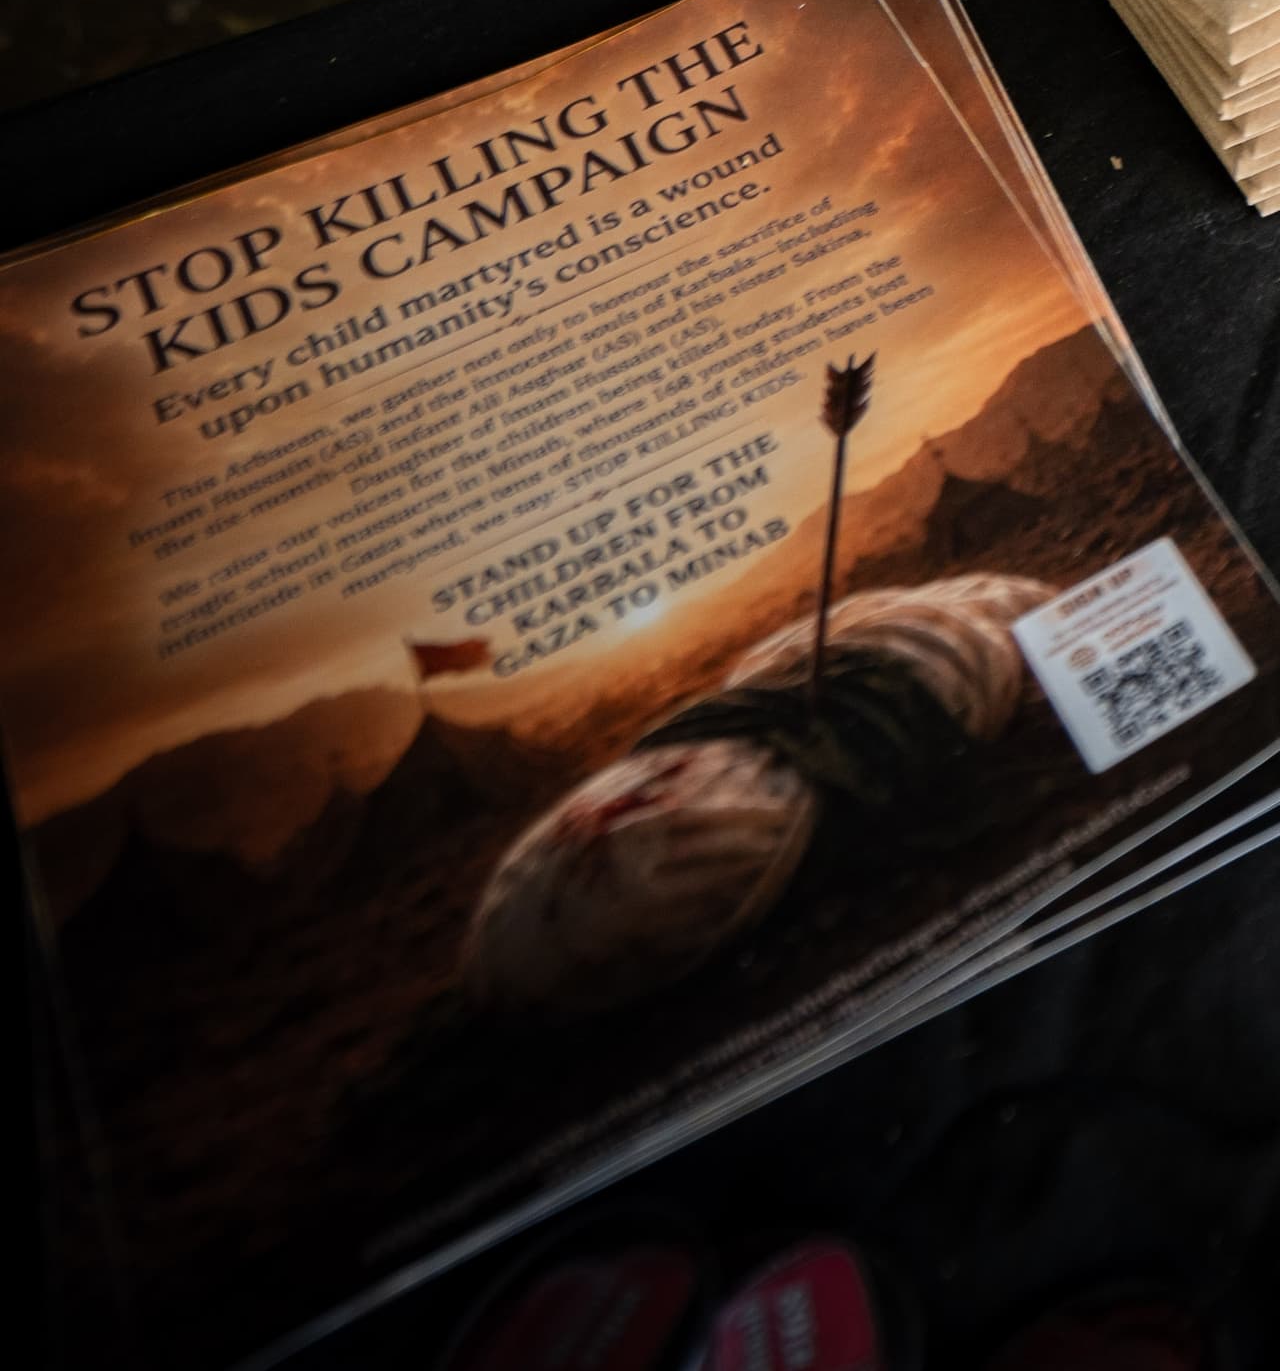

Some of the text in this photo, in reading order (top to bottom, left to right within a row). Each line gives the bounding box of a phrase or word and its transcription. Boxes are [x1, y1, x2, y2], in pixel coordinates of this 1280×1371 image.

[70, 21, 764, 338] STOP KILLING THE
[142, 85, 748, 374] KIDS CAMPAIGN
[151, 132, 784, 426] Every child martyred is a wound
[198, 183, 771, 440] upon humanity's conscience.
[430, 432, 780, 611] STAND UP FOR THE
[464, 464, 769, 626] CHILDREN FROM
[492, 518, 788, 672] GAZA TO MINAB
[511, 506, 749, 636] KARBALA TO
